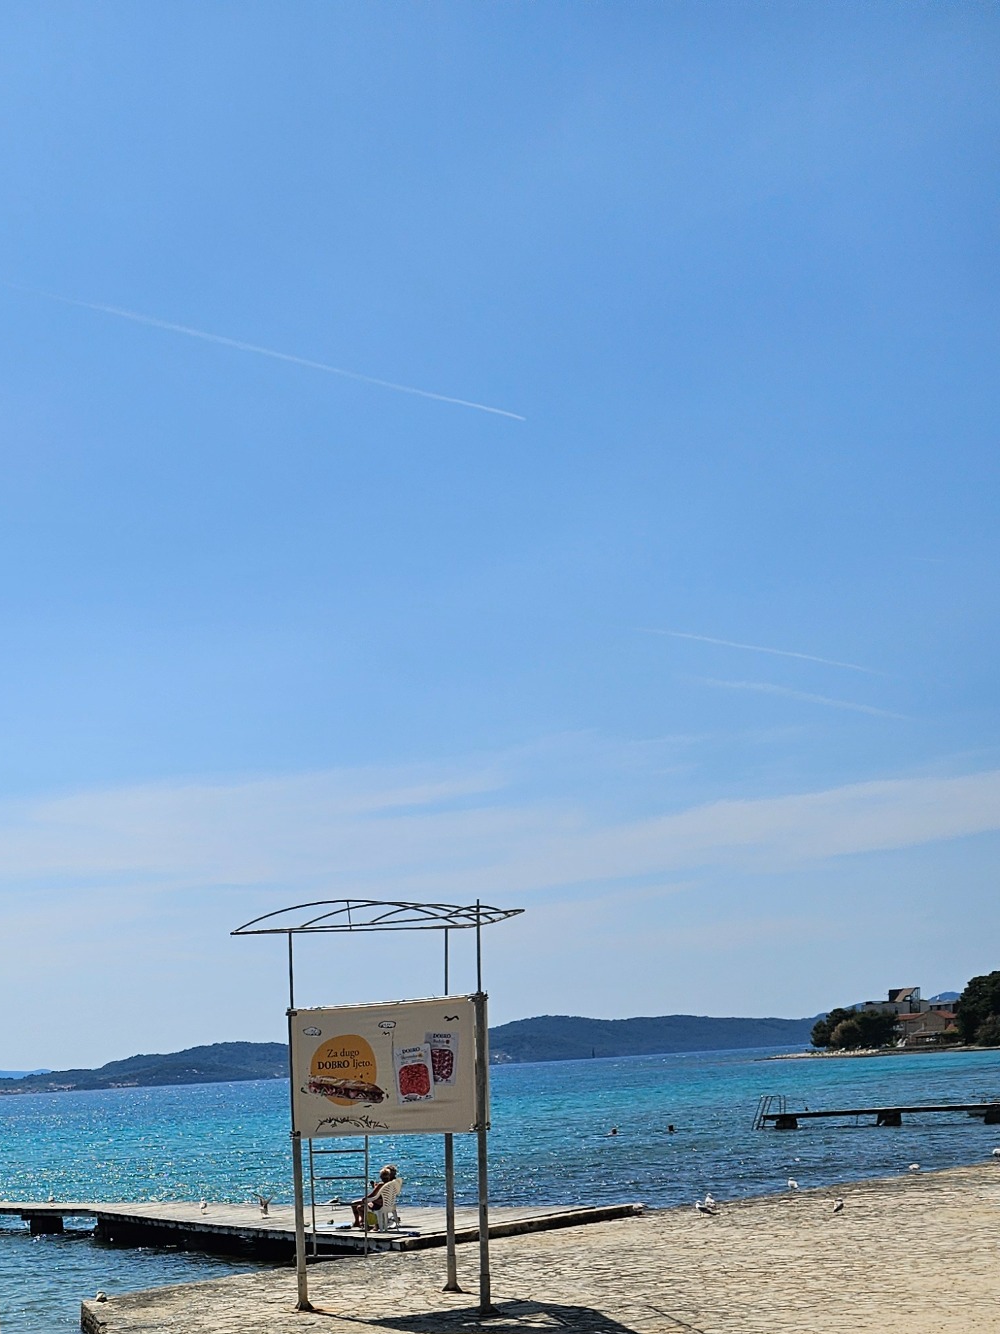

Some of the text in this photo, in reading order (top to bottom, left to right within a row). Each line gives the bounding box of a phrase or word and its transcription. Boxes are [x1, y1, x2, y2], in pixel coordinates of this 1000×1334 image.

[327, 1048, 360, 1059] Za dugo
[317, 1059, 373, 1070] DOBRO ljeto.
